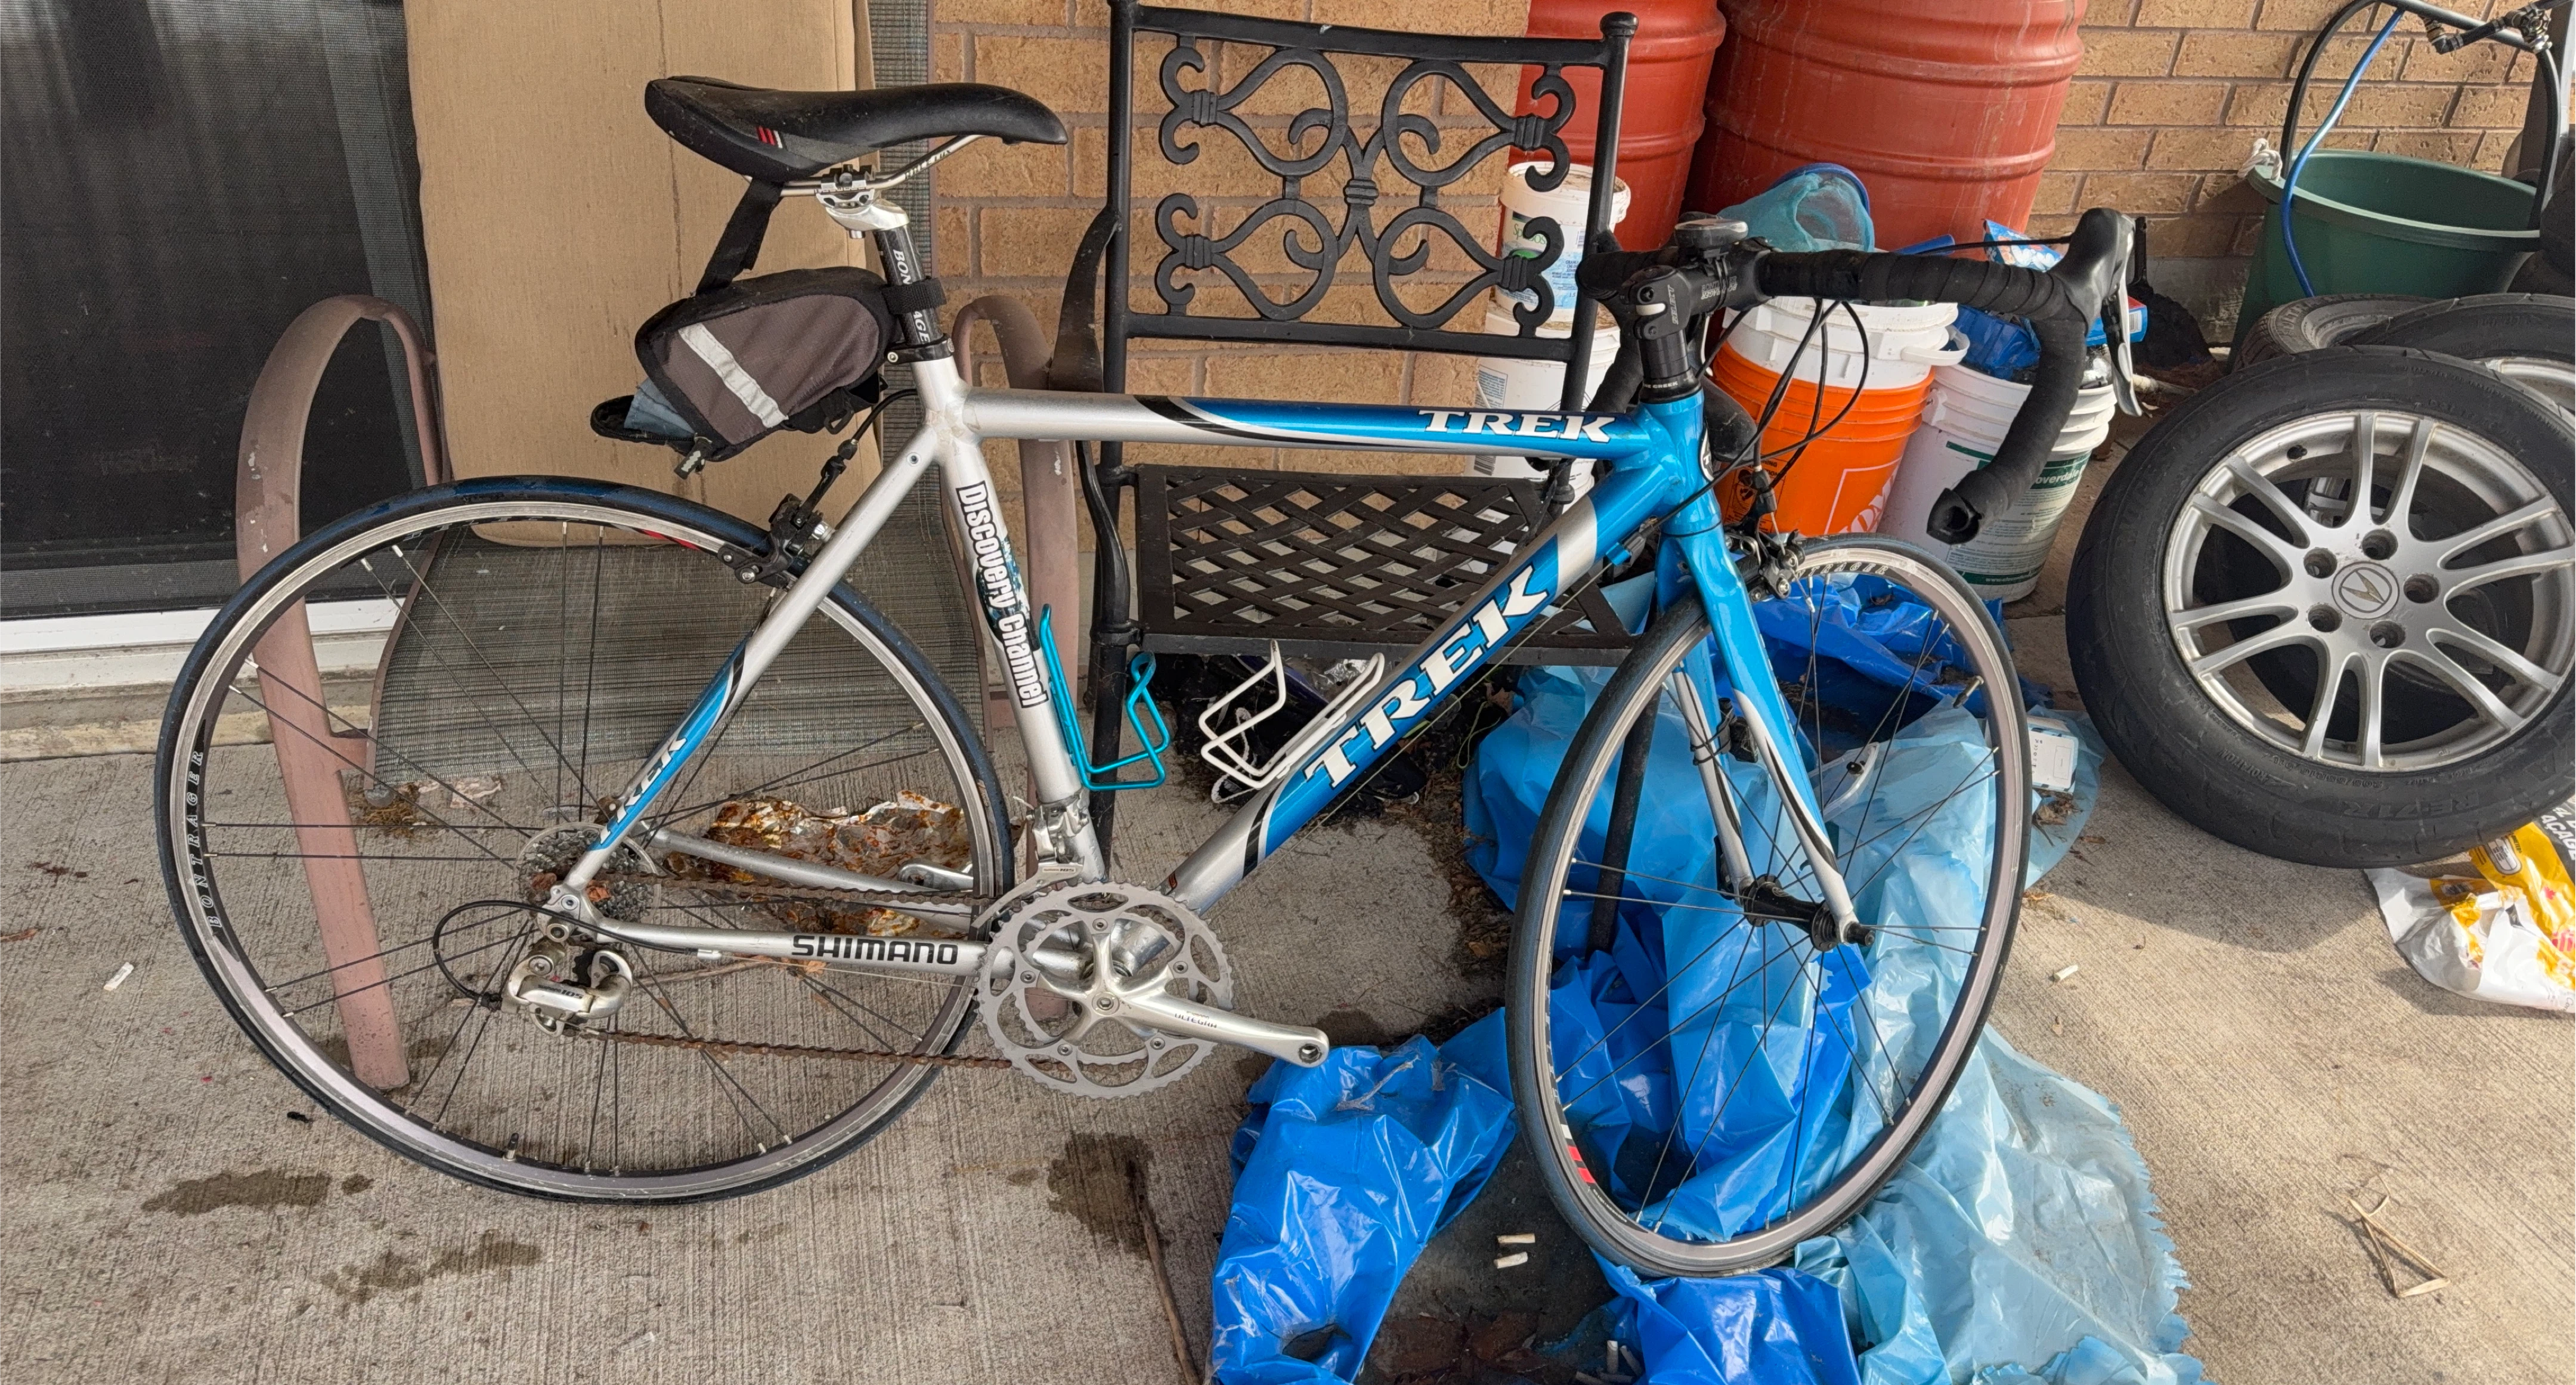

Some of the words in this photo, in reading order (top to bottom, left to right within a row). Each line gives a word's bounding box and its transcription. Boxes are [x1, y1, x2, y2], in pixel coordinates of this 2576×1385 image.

[893, 248, 932, 345] BONAGE
[1418, 410, 1616, 444] TREK
[2035, 469, 2080, 485] overdale
[1792, 561, 1889, 582] NTRAGER
[997, 612, 1049, 709] Channel
[1303, 562, 1549, 790] TREK
[2218, 748, 2269, 784] ROTATION
[600, 737, 687, 845] TREK
[186, 750, 222, 928] BONTRAGER
[791, 935, 959, 965] SHIMANO
[562, 989, 584, 999] 105
[1174, 1013, 1218, 1028] ULTEGRA
